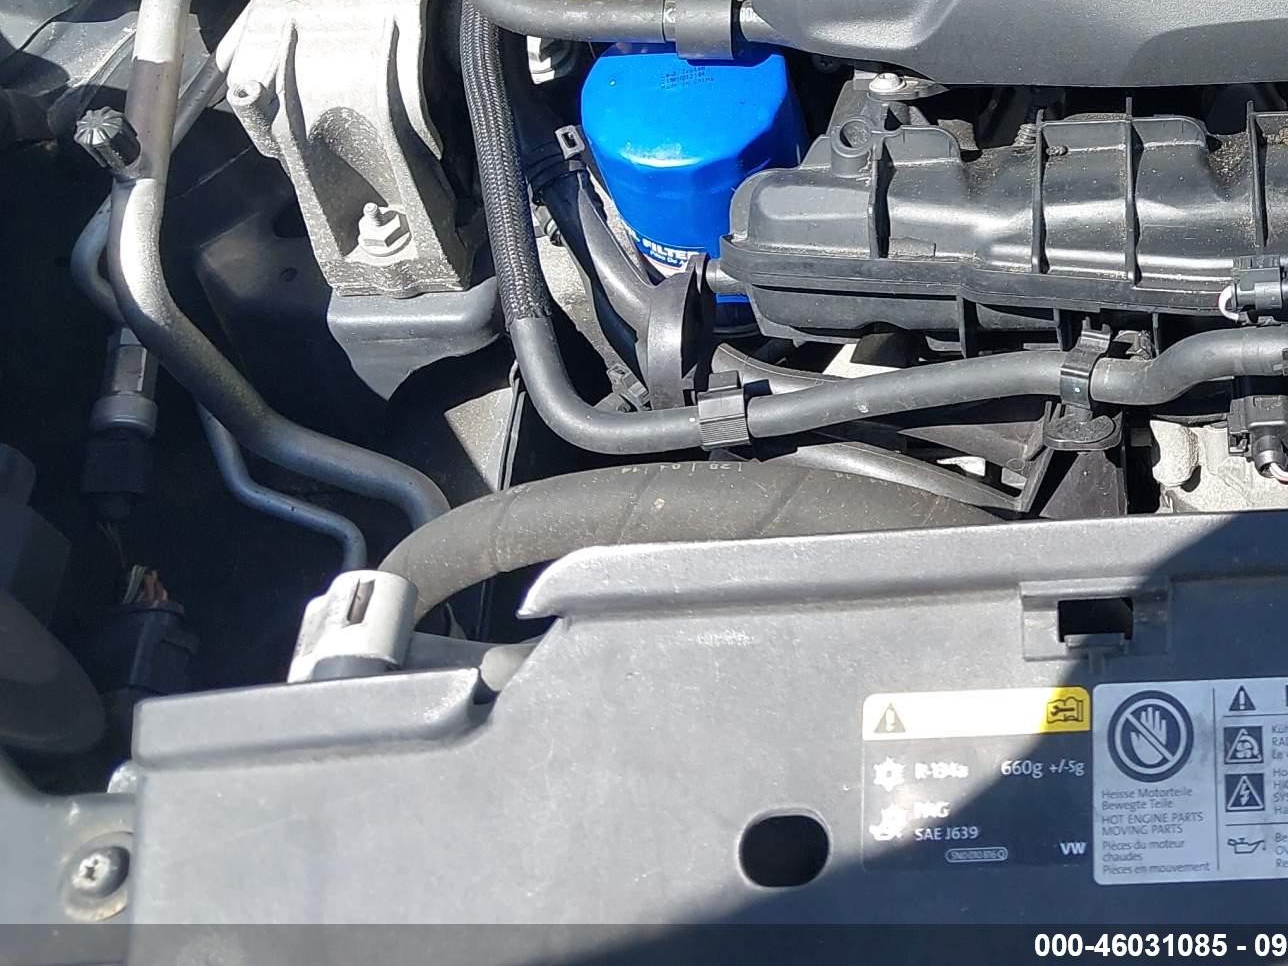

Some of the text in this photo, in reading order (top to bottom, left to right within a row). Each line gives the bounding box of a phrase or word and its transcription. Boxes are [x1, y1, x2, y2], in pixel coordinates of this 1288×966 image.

[1001, 759, 1044, 778] 660g
[1049, 758, 1086, 776] +/-5g
[915, 826, 978, 841] SAE J639
[1060, 842, 1086, 854] VW
